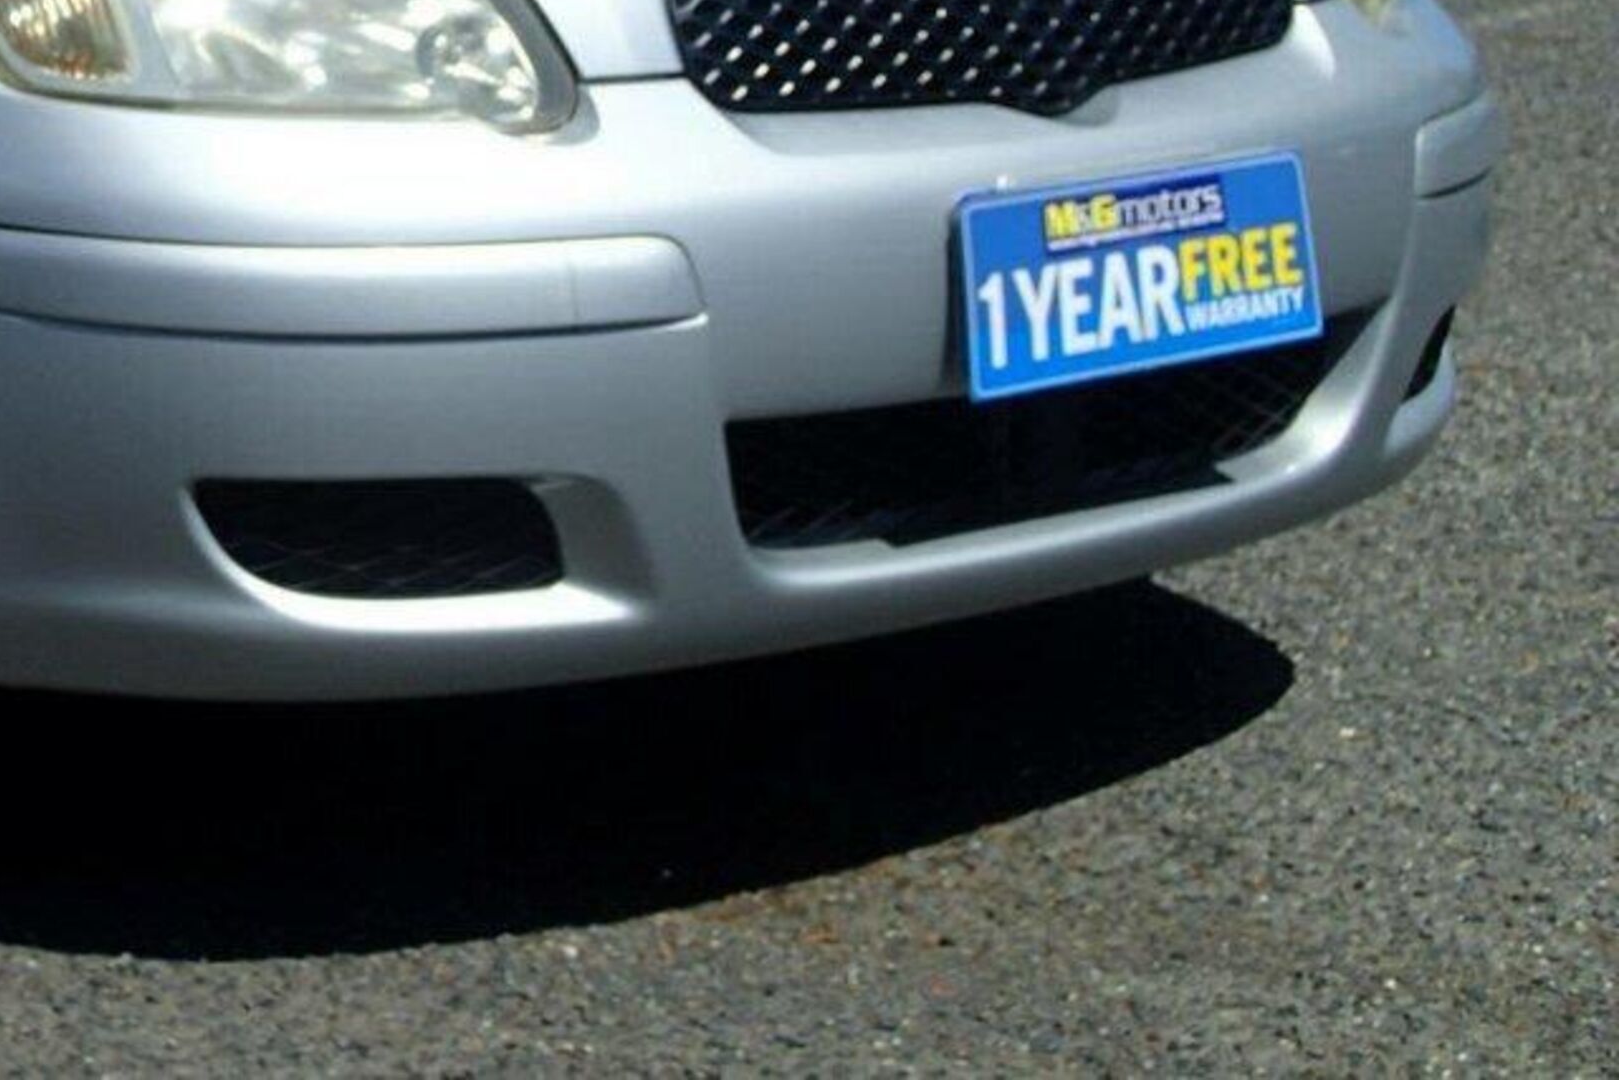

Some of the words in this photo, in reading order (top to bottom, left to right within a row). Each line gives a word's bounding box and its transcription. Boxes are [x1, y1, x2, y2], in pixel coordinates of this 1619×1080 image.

[978, 273, 1007, 369] 1
[1013, 245, 1183, 361] YEAR
[1180, 223, 1303, 302] FREE
[1185, 287, 1304, 332] WARRANTY
